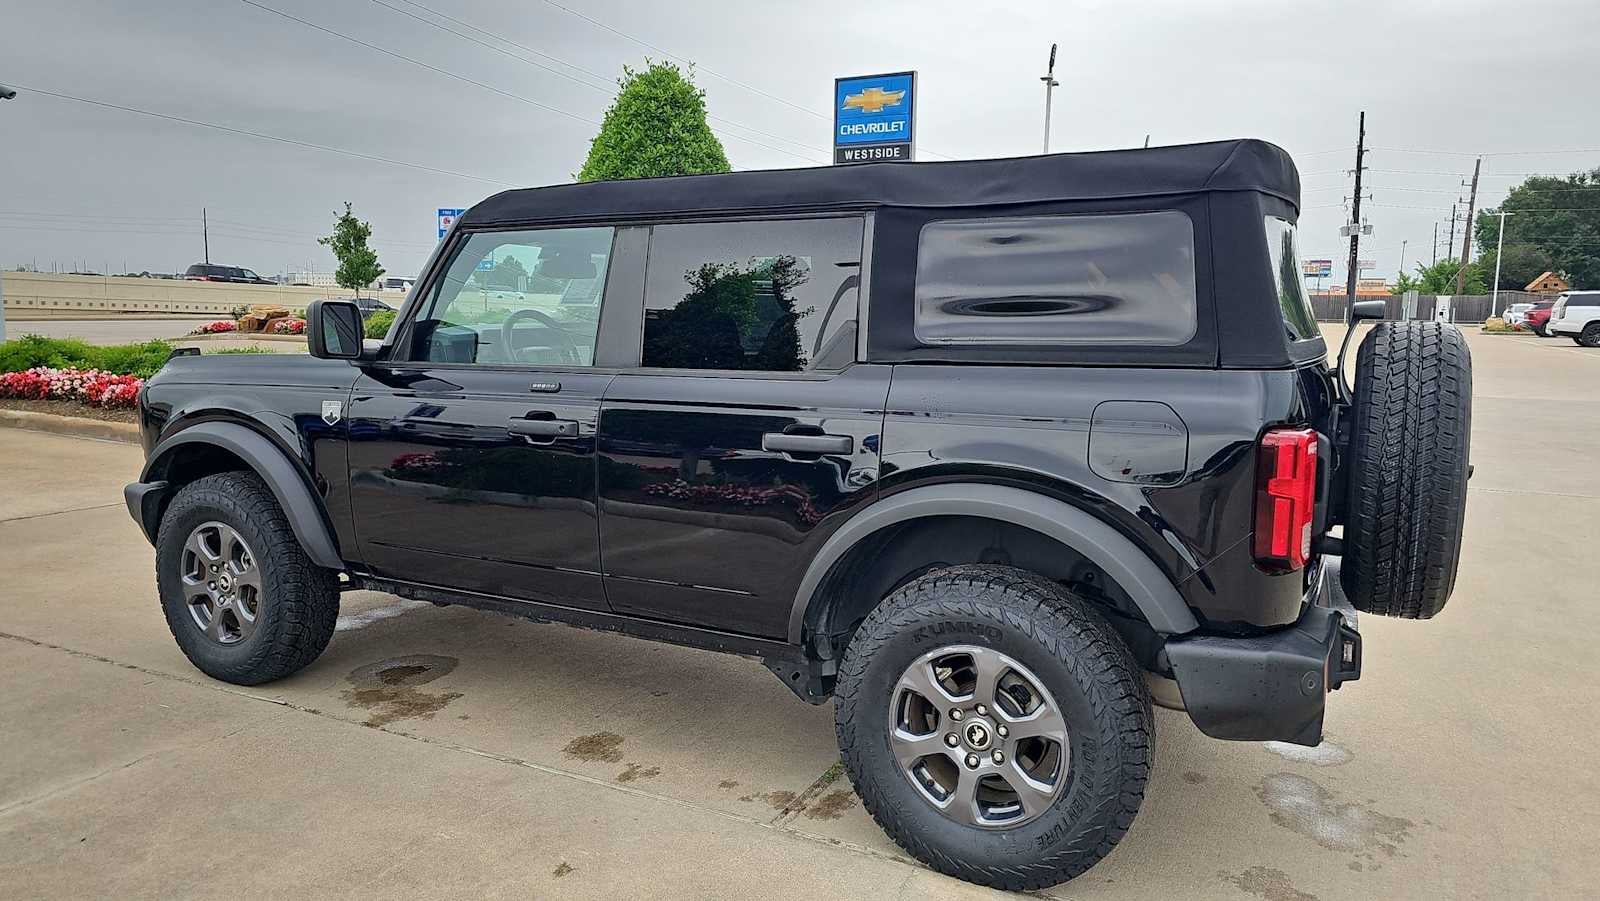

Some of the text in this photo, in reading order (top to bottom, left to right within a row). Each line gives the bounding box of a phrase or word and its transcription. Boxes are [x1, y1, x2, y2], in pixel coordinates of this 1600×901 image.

[840, 121, 906, 136] CHEVROLET
[844, 147, 901, 160] WESTSIDE
[912, 621, 1004, 643] KUMHO
